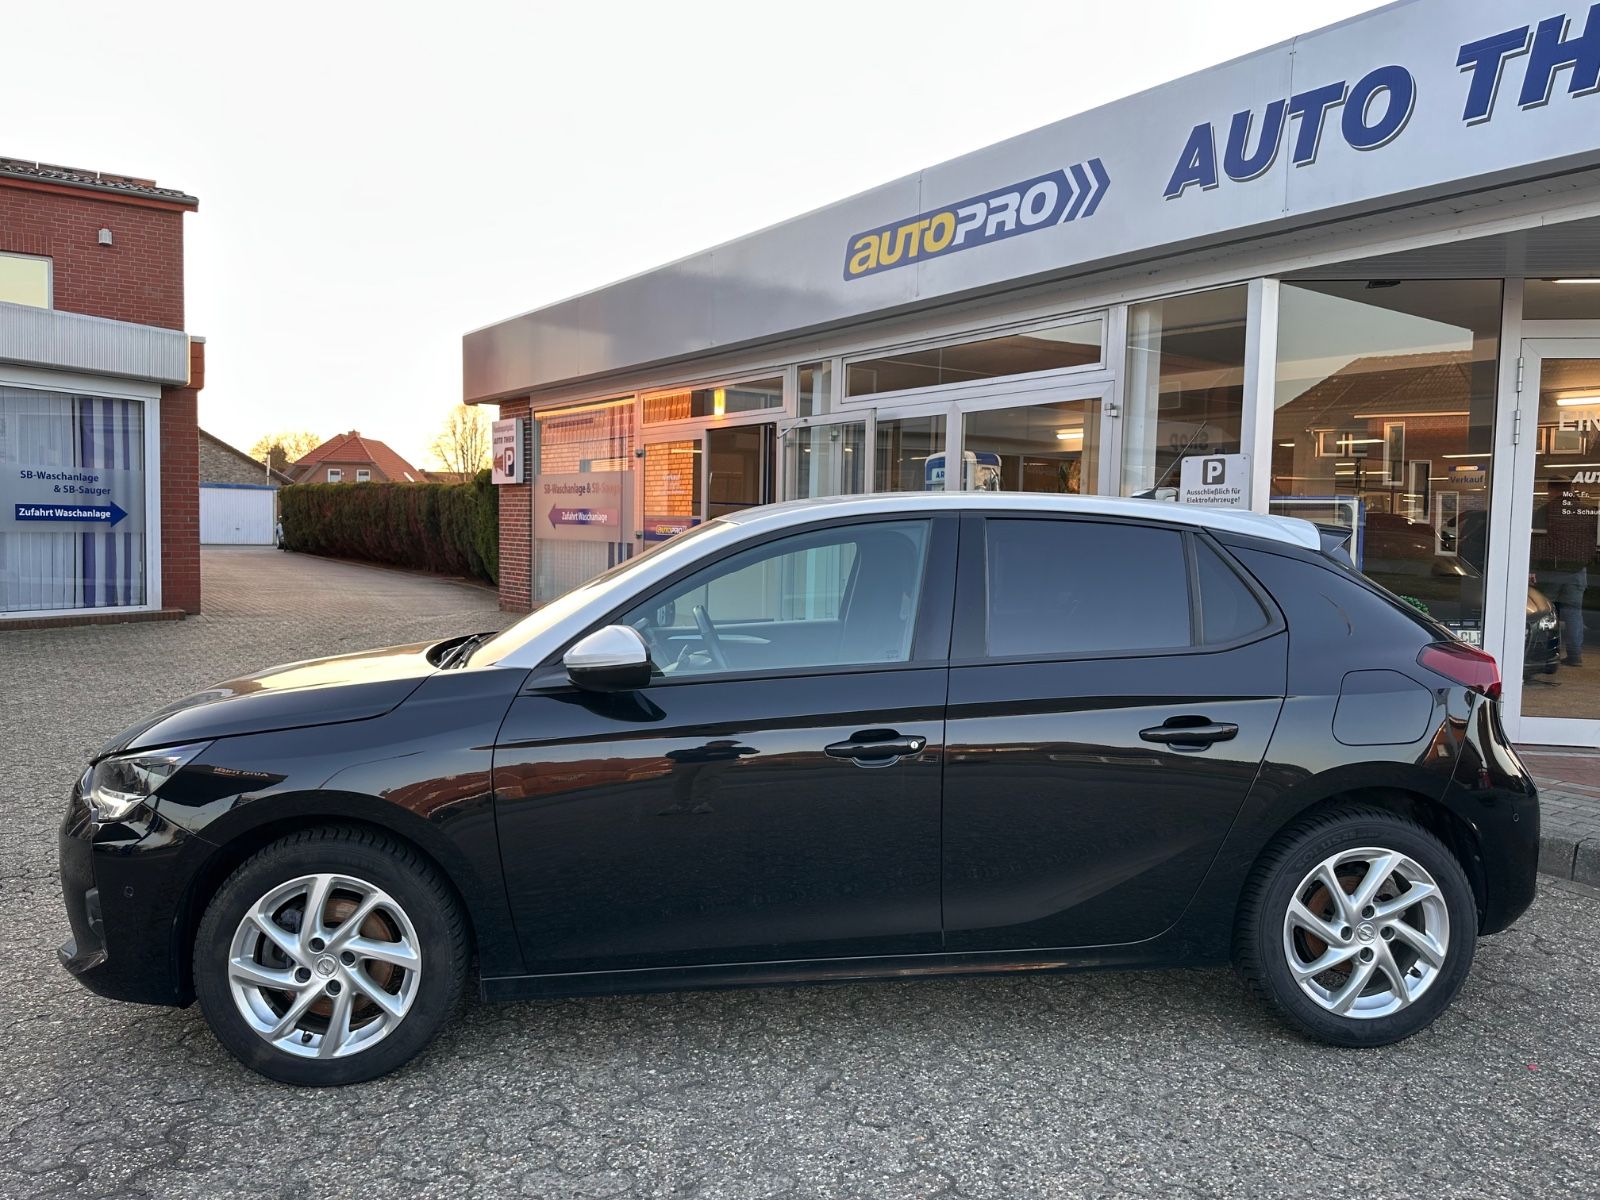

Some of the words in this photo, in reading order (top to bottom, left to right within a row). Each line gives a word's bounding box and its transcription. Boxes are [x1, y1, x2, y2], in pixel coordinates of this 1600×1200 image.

[1163, 65, 1416, 200] AUTO
[1456, 2, 1600, 127] TH
[505, 450, 514, 475] P
[20, 470, 99, 483] SB-Waschanlage
[1207, 461, 1223, 483] P
[53, 484, 61, 494] &
[63, 485, 112, 496] SB-Sauger
[1186, 487, 1230, 496] Ausschließlich
[1231, 487, 1241, 496] für
[18, 507, 54, 517] Zufahrt
[54, 508, 112, 519] Waschanlage
